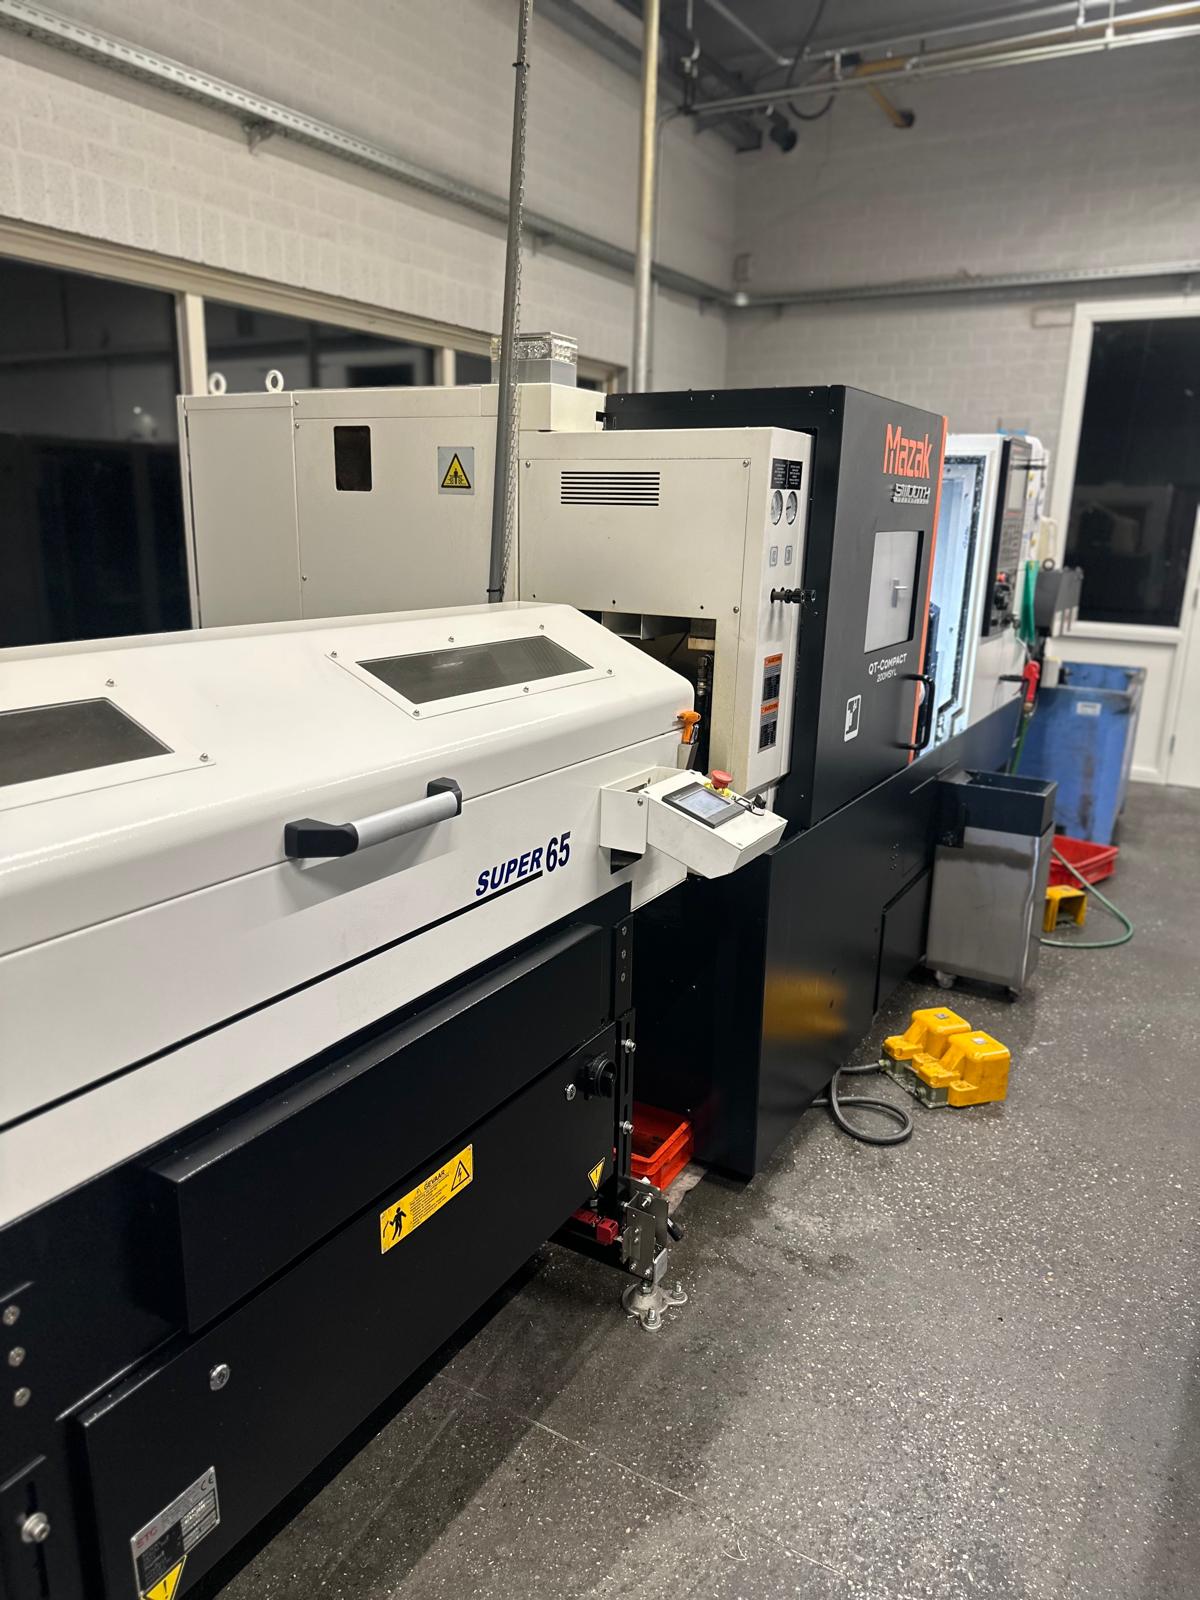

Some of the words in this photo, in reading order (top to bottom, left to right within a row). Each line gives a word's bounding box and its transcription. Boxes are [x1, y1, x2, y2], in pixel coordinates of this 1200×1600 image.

[883, 423, 932, 479] Mazak
[868, 653, 907, 675] QT-COMPACT
[475, 847, 543, 896] SUPER
[546, 831, 571, 872] 65
